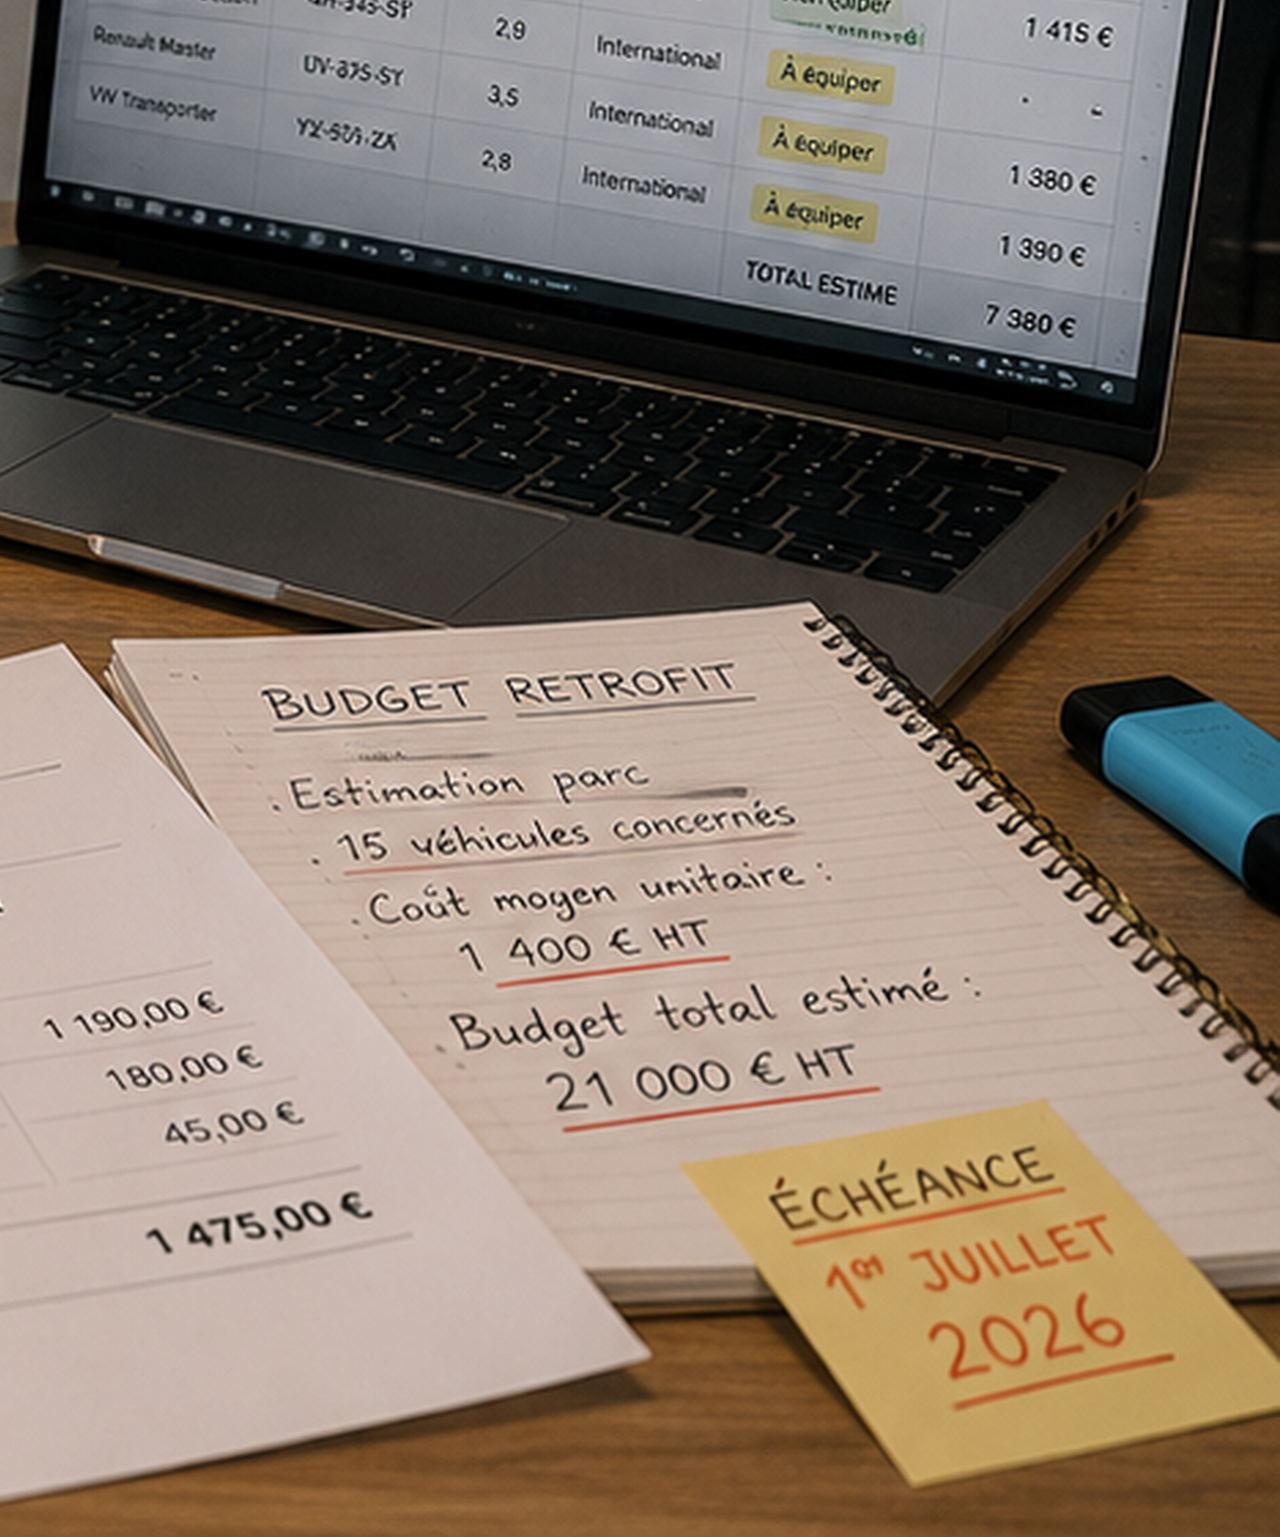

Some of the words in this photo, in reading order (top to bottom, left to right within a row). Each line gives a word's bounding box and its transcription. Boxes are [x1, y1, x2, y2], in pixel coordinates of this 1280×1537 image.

[496, 17, 526, 40] 2,9
[1046, 21, 1089, 43] 415
[598, 35, 721, 70] International
[488, 84, 518, 107] 3,5
[589, 101, 714, 138] International
[482, 150, 511, 172] 2,8
[582, 166, 706, 203] International
[1028, 168, 1073, 192] 380
[1019, 238, 1063, 263] 390
[747, 260, 812, 290] TOTAL
[1007, 309, 1053, 335] 380
[260, 681, 471, 721] BUDGET
[505, 663, 734, 703] RETROFIT
[290, 770, 525, 808] Estimation
[553, 766, 649, 804] parc
[337, 832, 387, 860] 15
[410, 819, 590, 858] véhicules
[612, 800, 796, 842] concernés
[370, 884, 470, 924] Coût
[494, 886, 616, 922] moyen
[640, 862, 805, 898] unitaire
[510, 935, 591, 966] 400
[653, 919, 707, 950] HT
[74, 998, 189, 1034] 190,00
[449, 1001, 626, 1058] Budget
[655, 984, 777, 1030] total
[803, 967, 949, 1014] estimé
[106, 1053, 228, 1090] 180,00
[546, 1071, 613, 1111] 21
[636, 1060, 730, 1100] 000
[796, 1044, 854, 1079] HT
[166, 1109, 267, 1144] 45,00
[768, 1146, 1055, 1231] ÉCHÉANCE
[188, 1201, 331, 1247] 475,00
[909, 1214, 1114, 1292] JUILLET
[928, 1292, 1125, 1380] 2026
